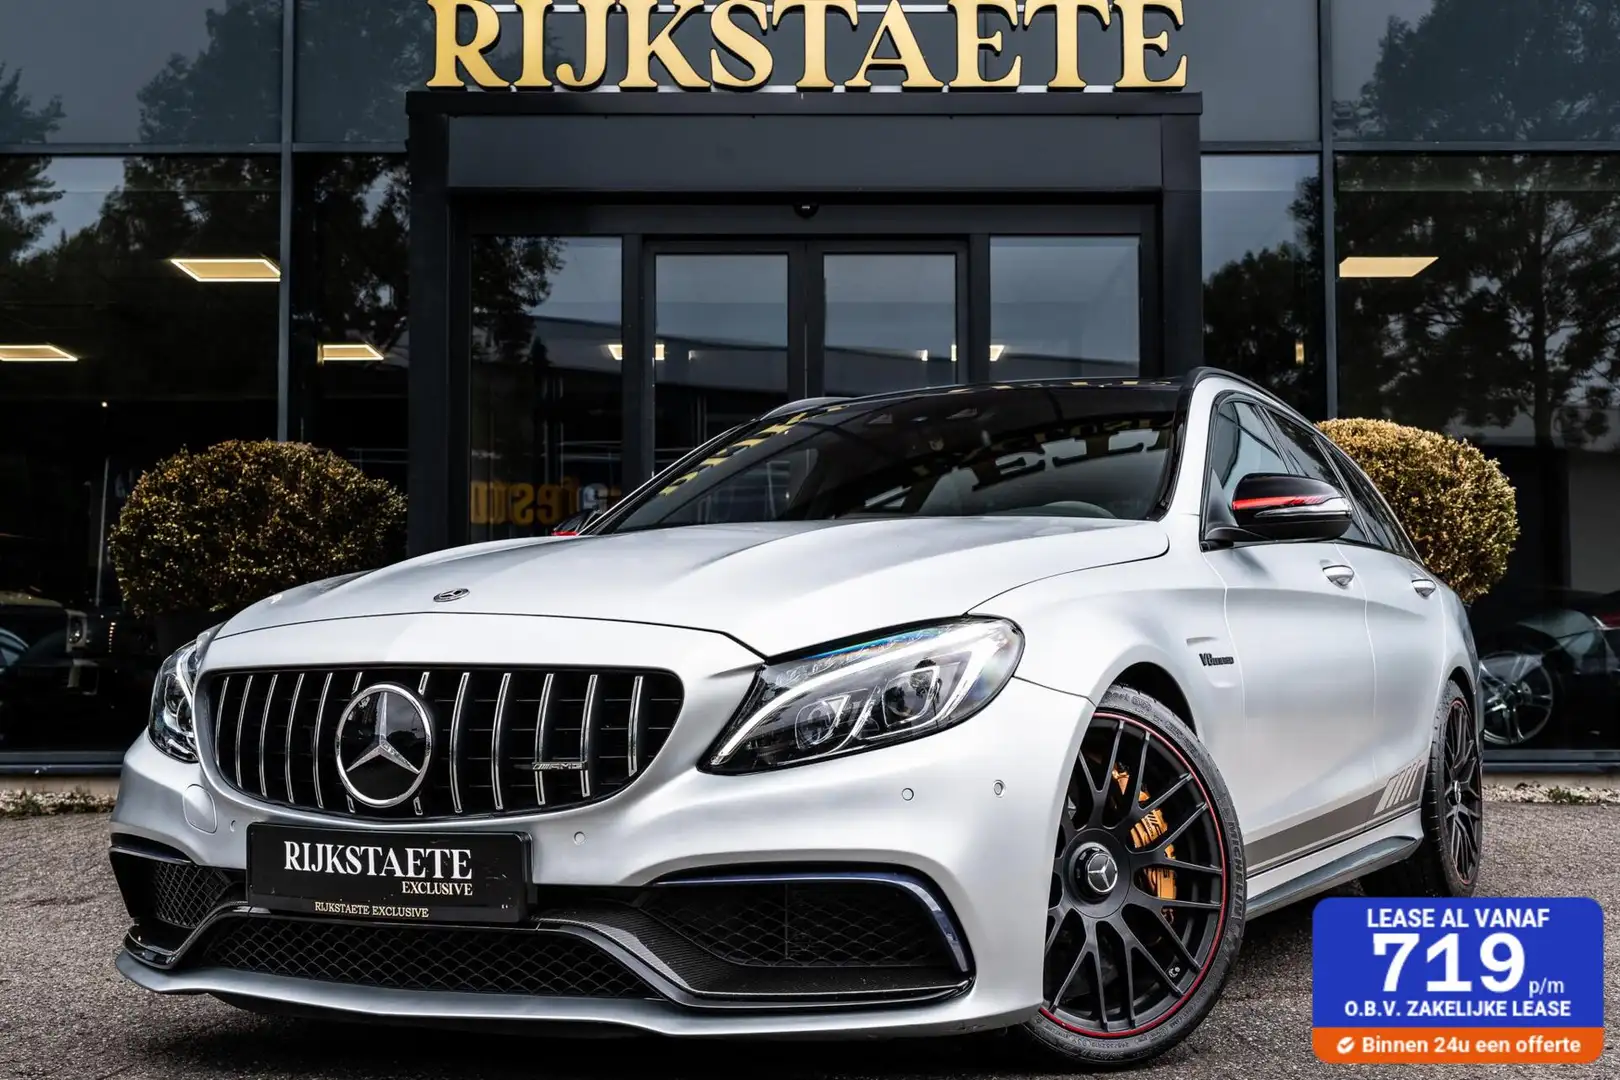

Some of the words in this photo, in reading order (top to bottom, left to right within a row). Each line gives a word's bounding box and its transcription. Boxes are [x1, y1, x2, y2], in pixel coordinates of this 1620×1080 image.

[425, 0, 1188, 89] RIJKSTAETE
[283, 840, 473, 880] RIJKSTAETE
[401, 880, 473, 896] EXCLUSIVE
[314, 901, 370, 915] RIJKSTAETE
[372, 905, 430, 918] EXCLUSIVE
